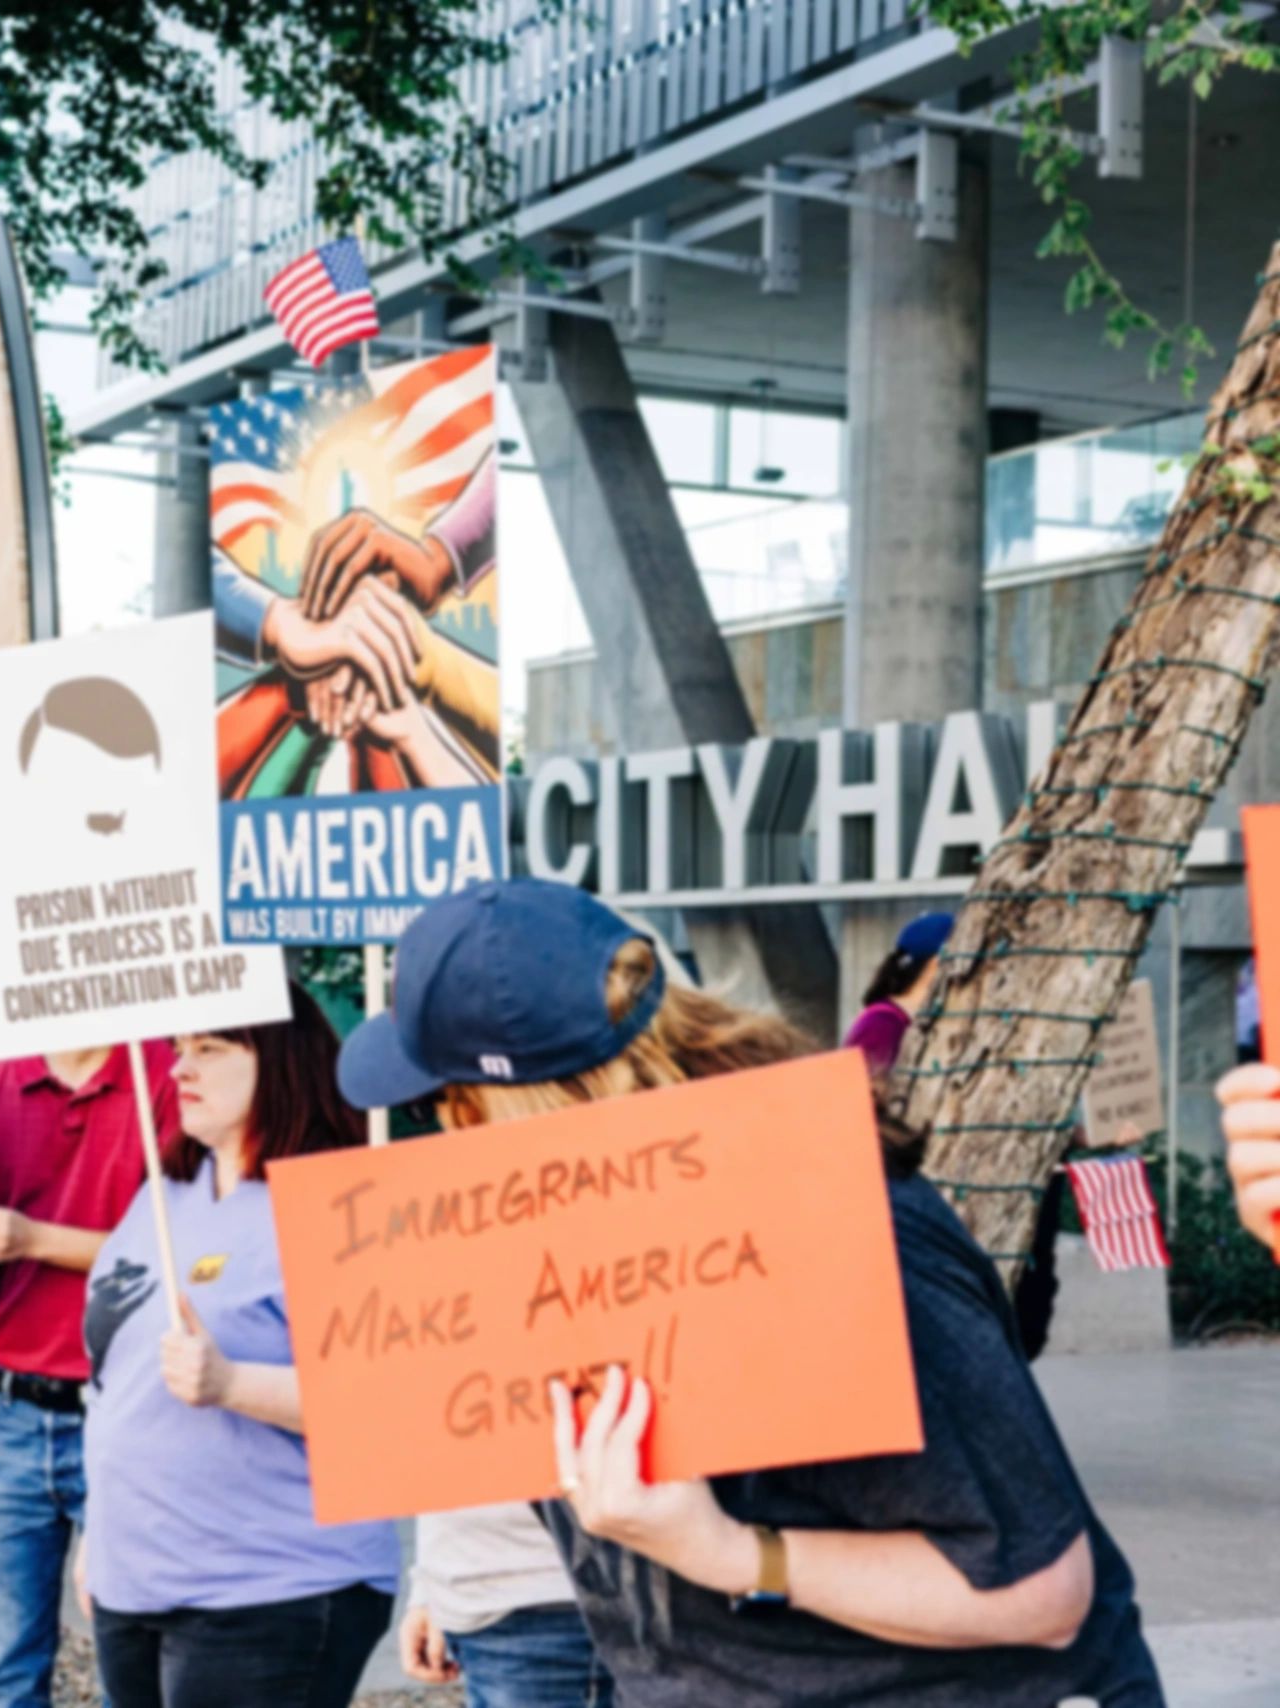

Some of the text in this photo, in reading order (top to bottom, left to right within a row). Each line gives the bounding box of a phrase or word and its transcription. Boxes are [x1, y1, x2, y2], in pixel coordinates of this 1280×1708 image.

[226, 800, 495, 901] AMERICA
[526, 737, 772, 895] CITY
[15, 868, 198, 932] PRISON WITHOUT
[227, 908, 271, 939] WAS
[275, 908, 329, 939] BUILT
[332, 907, 358, 938] BY
[19, 912, 219, 976] DUE PROCESS IS A
[2, 954, 247, 1024] CONCENTRATION CAMP
[329, 1132, 707, 1266] IMMIGRANTS
[319, 1230, 769, 1363] MAKE AMERICA
